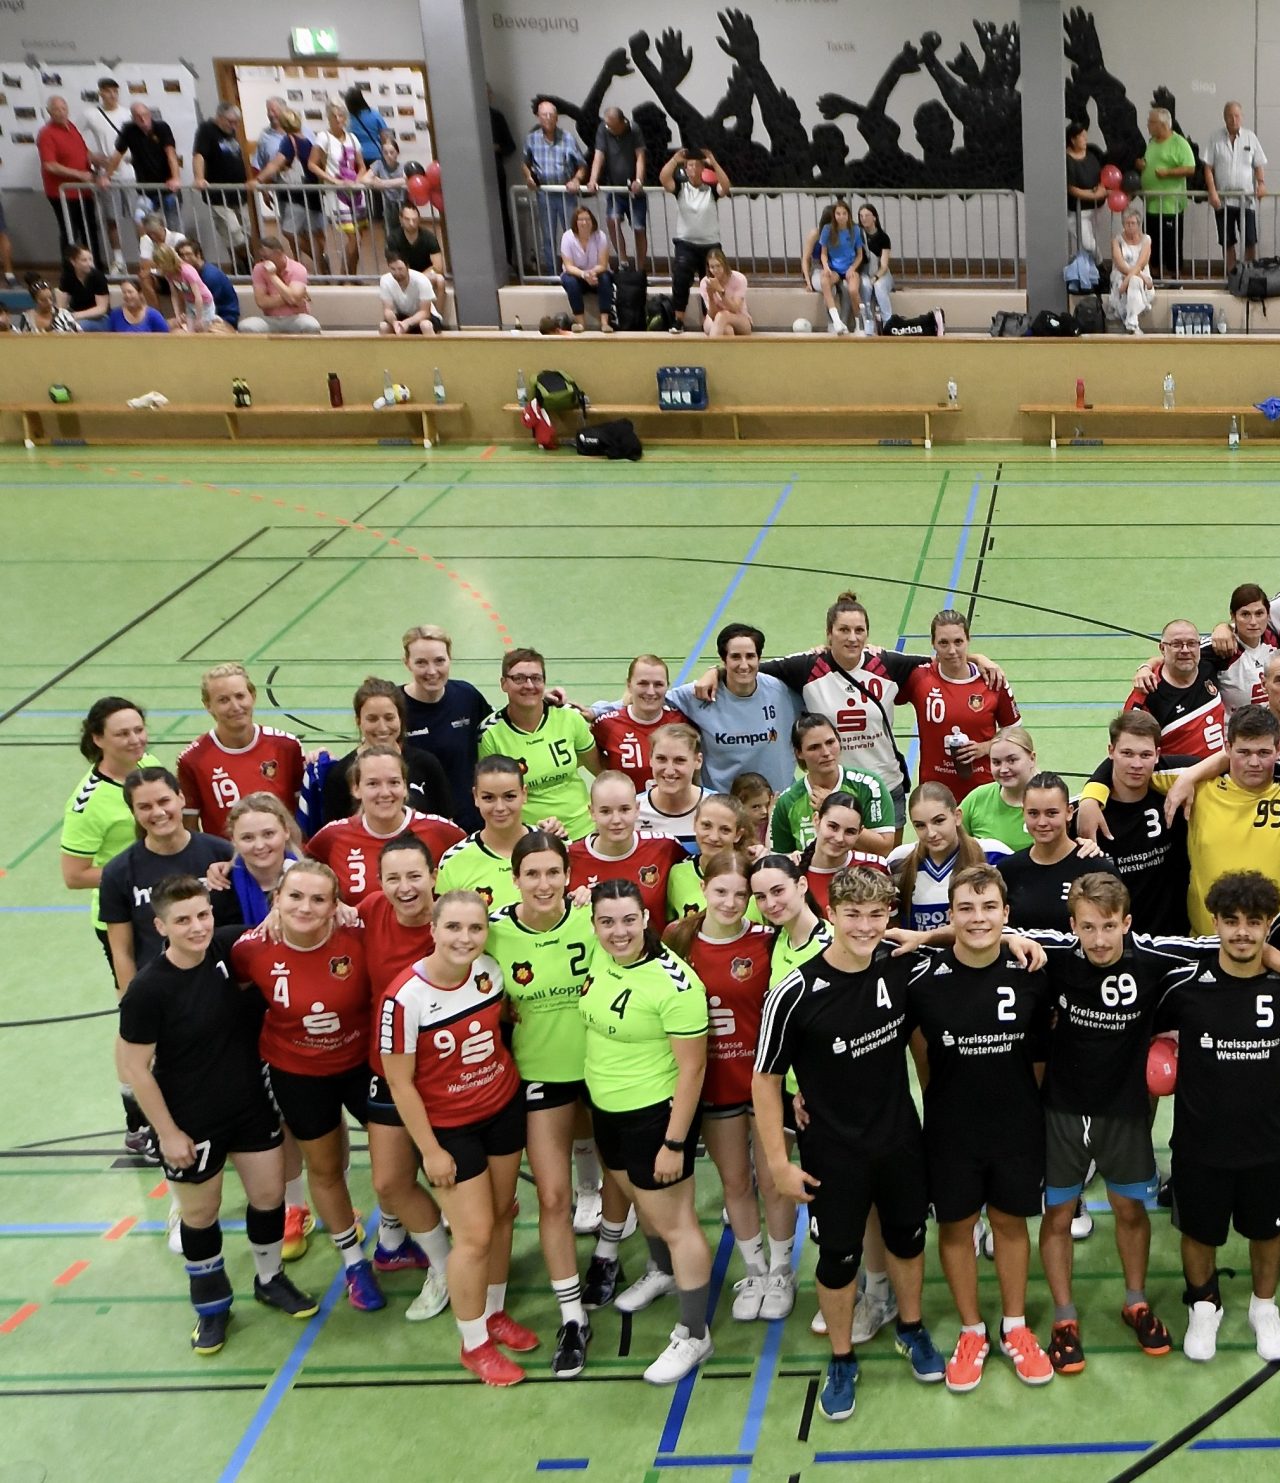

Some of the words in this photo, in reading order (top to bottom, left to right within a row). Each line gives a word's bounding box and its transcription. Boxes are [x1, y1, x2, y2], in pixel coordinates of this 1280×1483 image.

[492, 12, 579, 33] Bewegung
[891, 325, 923, 336] adidas
[762, 705, 776, 720] 16
[926, 697, 945, 723] 10
[715, 733, 768, 746] Kempa
[549, 739, 572, 767] 15
[619, 743, 642, 768] 21
[212, 778, 240, 808] 19
[1144, 808, 1162, 838] 3
[350, 862, 366, 893] 3
[1118, 855, 1165, 874] Westerwald
[535, 938, 560, 948] hummel
[567, 942, 589, 976] 2
[273, 976, 290, 1009] 4
[876, 977, 892, 1009] 4
[1101, 973, 1138, 1007] 69
[610, 988, 632, 1019] 4
[997, 986, 1016, 1021] 2
[1070, 1004, 1142, 1021] Kreissparkasse
[1256, 994, 1274, 1028] 5
[1069, 1013, 1126, 1030] Westerwald
[434, 1029, 456, 1059] 9
[851, 1029, 898, 1059] Westerwald
[958, 1032, 1025, 1045] Kreissparkasse
[958, 1043, 1012, 1056] Westerwald
[1216, 1038, 1280, 1050] Kreissparkasse
[1216, 1050, 1270, 1061] Westerwald
